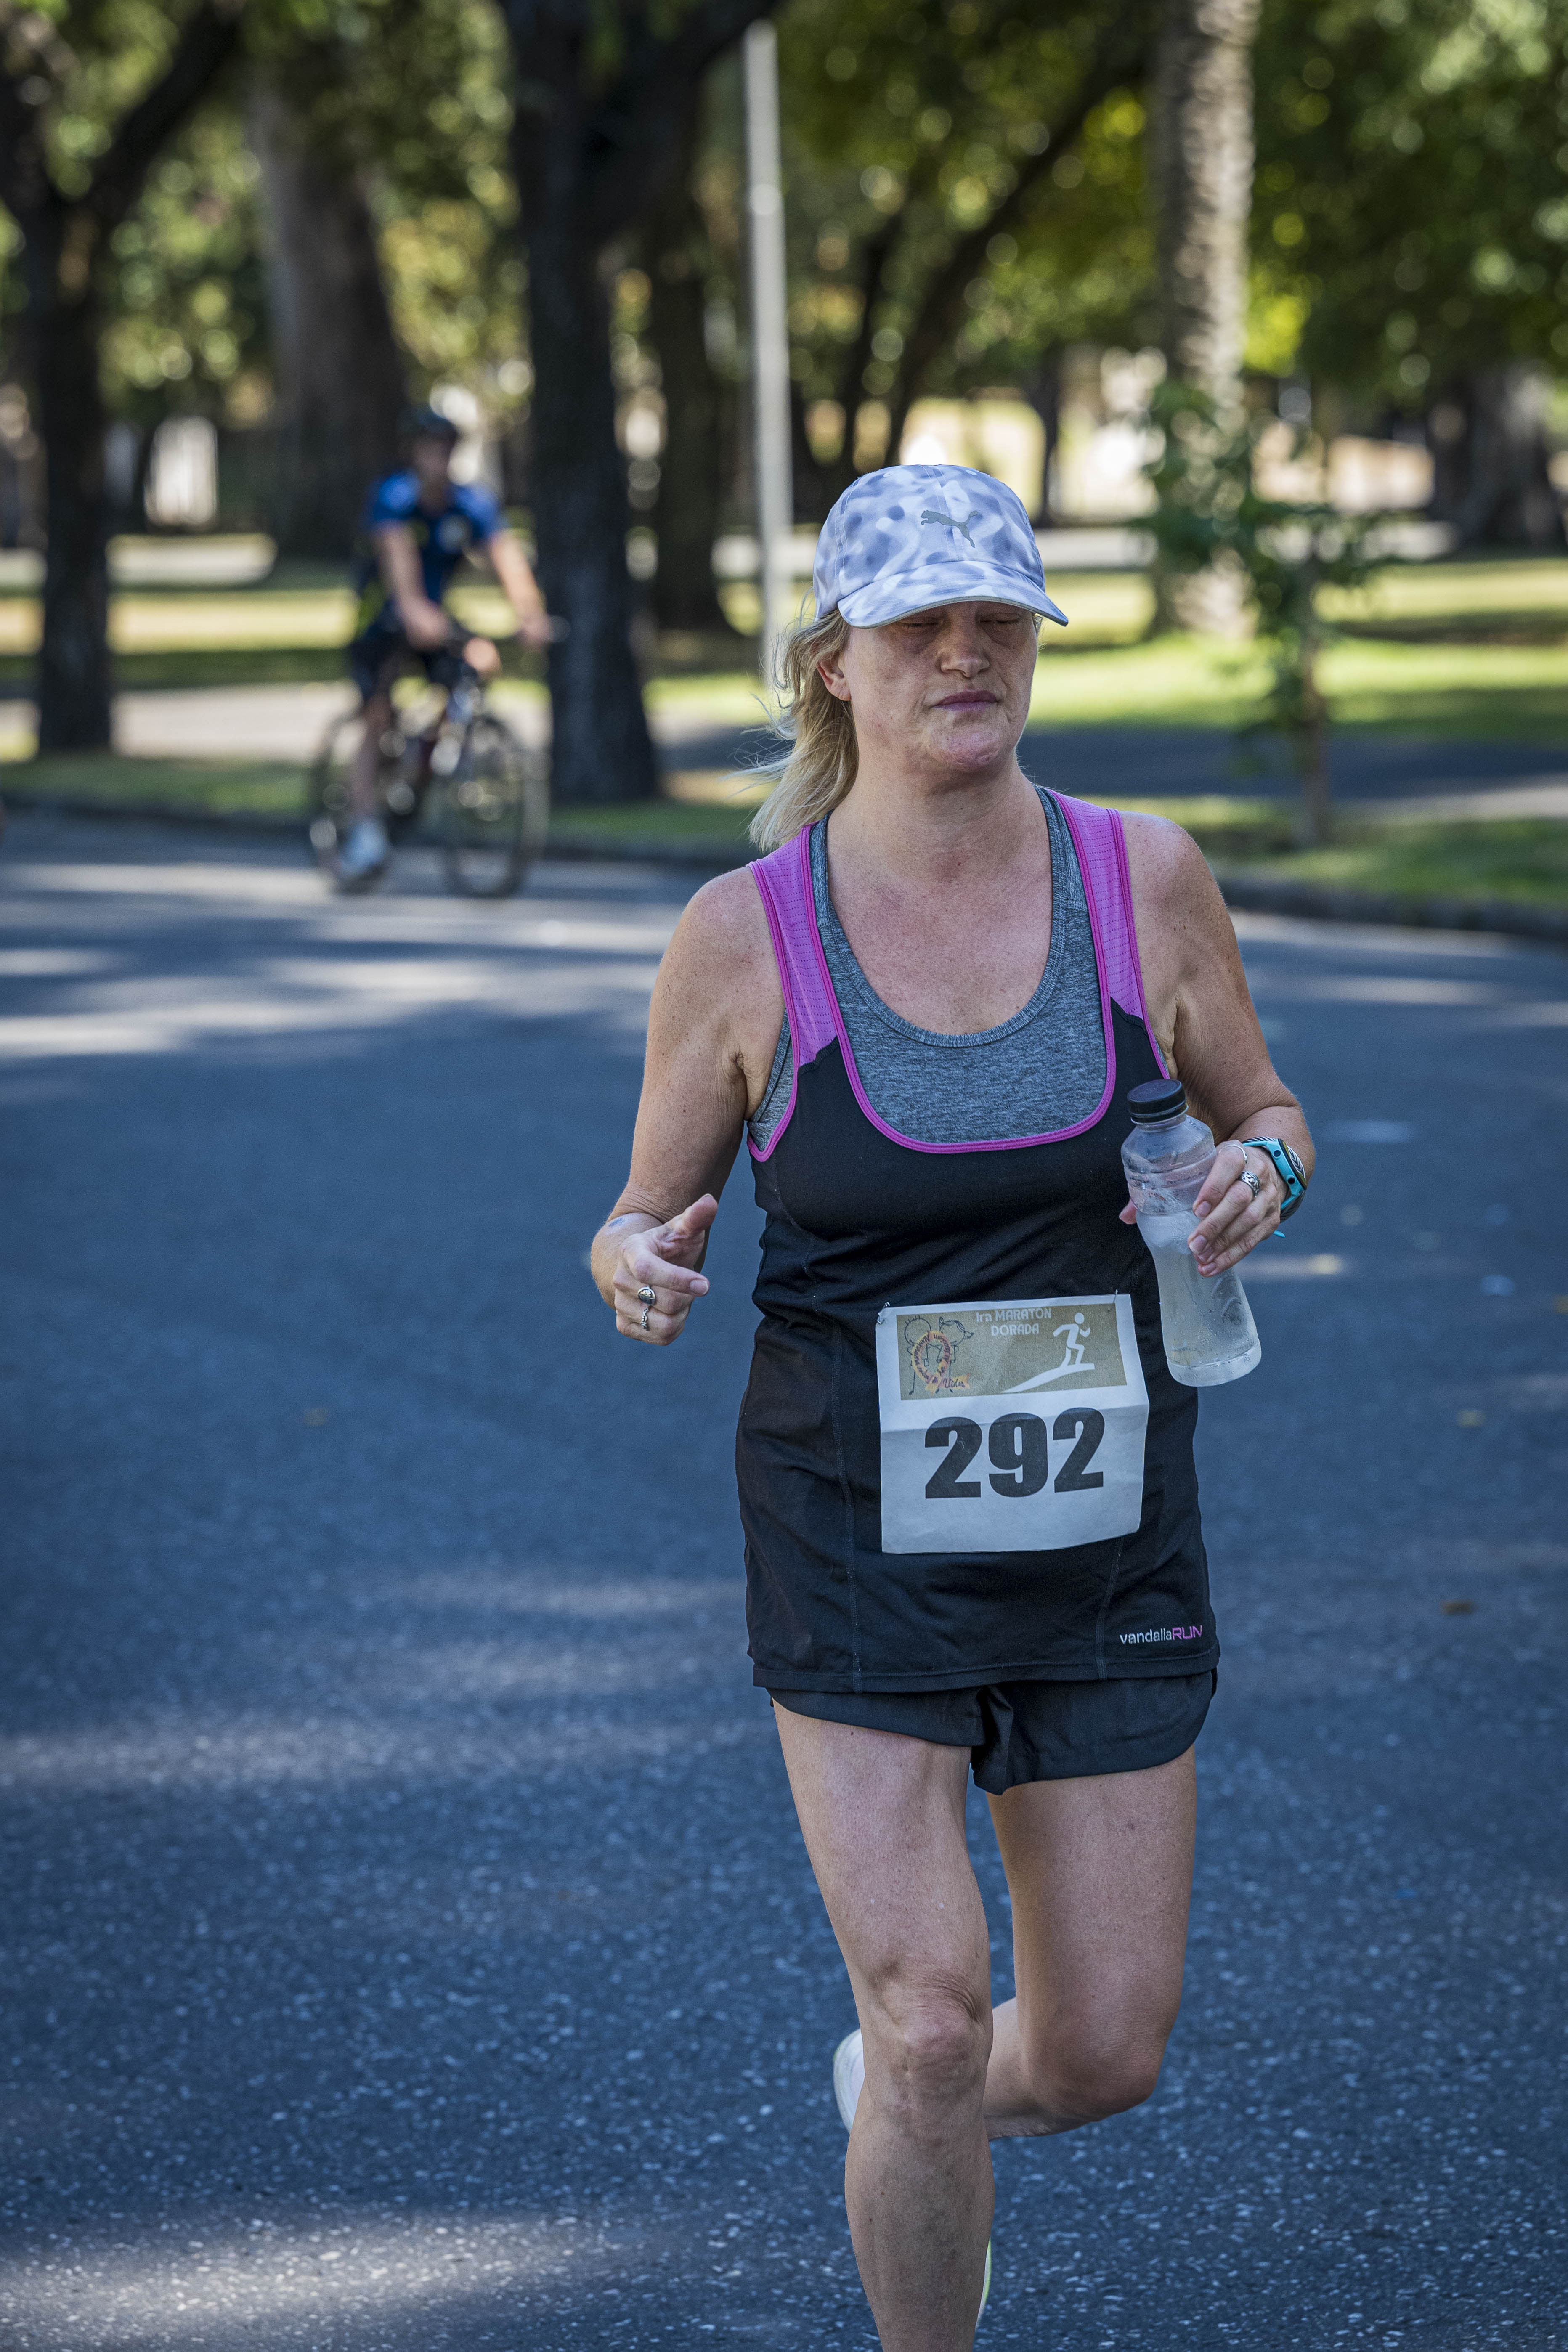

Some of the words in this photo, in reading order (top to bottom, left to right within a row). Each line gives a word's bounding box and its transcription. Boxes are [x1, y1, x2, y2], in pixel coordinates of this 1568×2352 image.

[995, 1307, 1052, 1321] MARATON
[991, 1323, 1040, 1336] DORADA
[925, 1407, 1105, 1499] 292
[1119, 1625, 1202, 1644] vandaliaRUN
